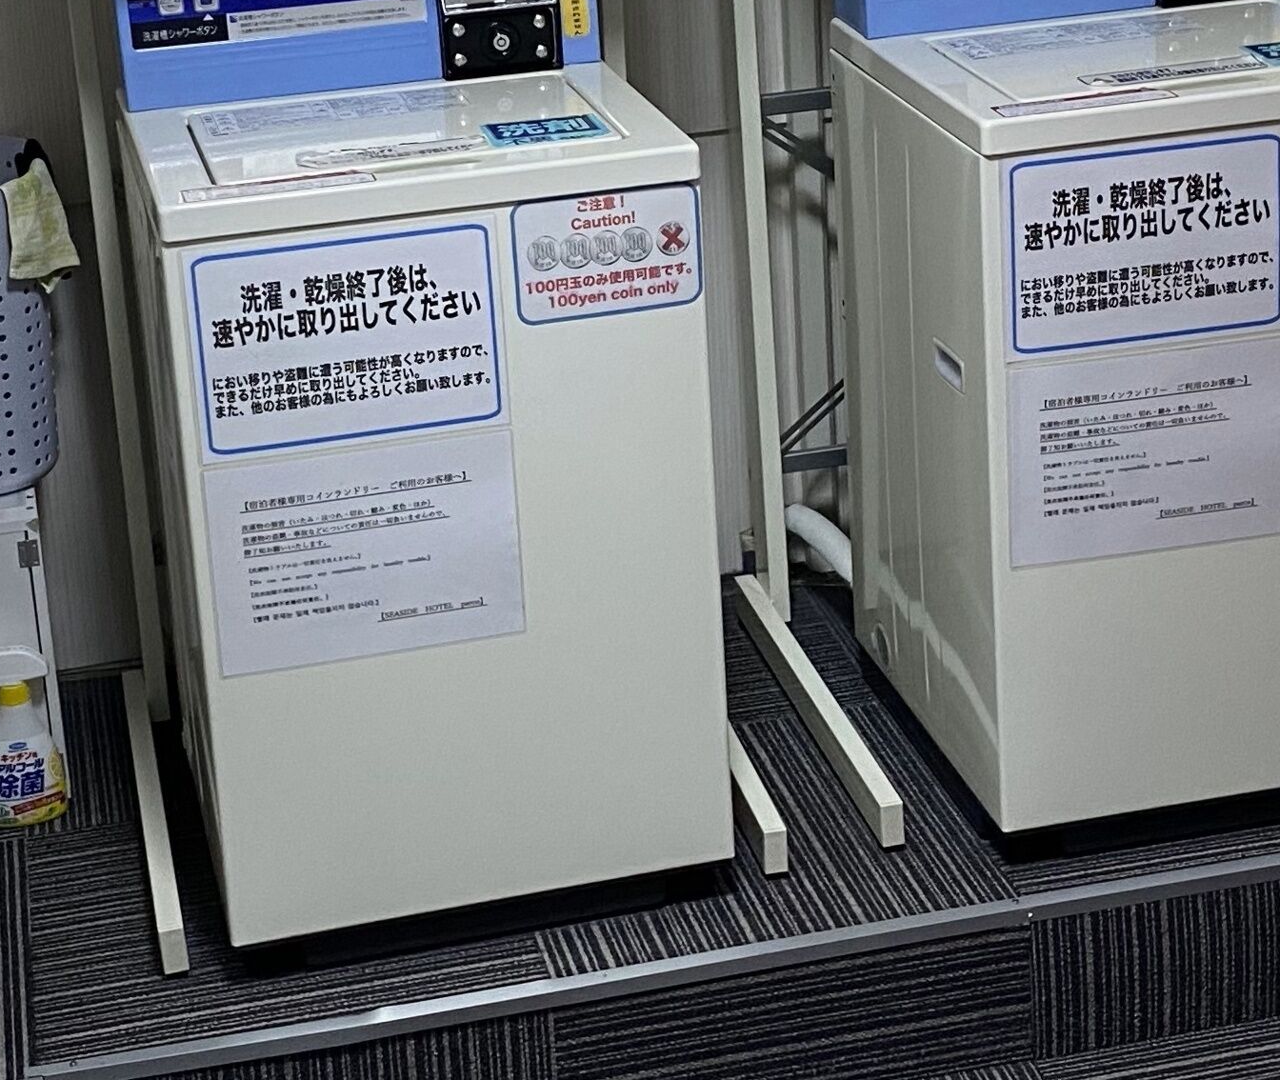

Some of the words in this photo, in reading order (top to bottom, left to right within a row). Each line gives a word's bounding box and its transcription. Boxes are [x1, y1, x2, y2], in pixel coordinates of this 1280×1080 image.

[571, 211, 636, 230] Caution!
[1024, 197, 1271, 252] 速やかに取り出してください
[525, 262, 692, 294] 100円玉のみ使用可能です。
[548, 289, 606, 311] 100yen
[611, 286, 643, 301] coin
[648, 280, 679, 298] only
[213, 291, 482, 350] 速やかに取り出してください
